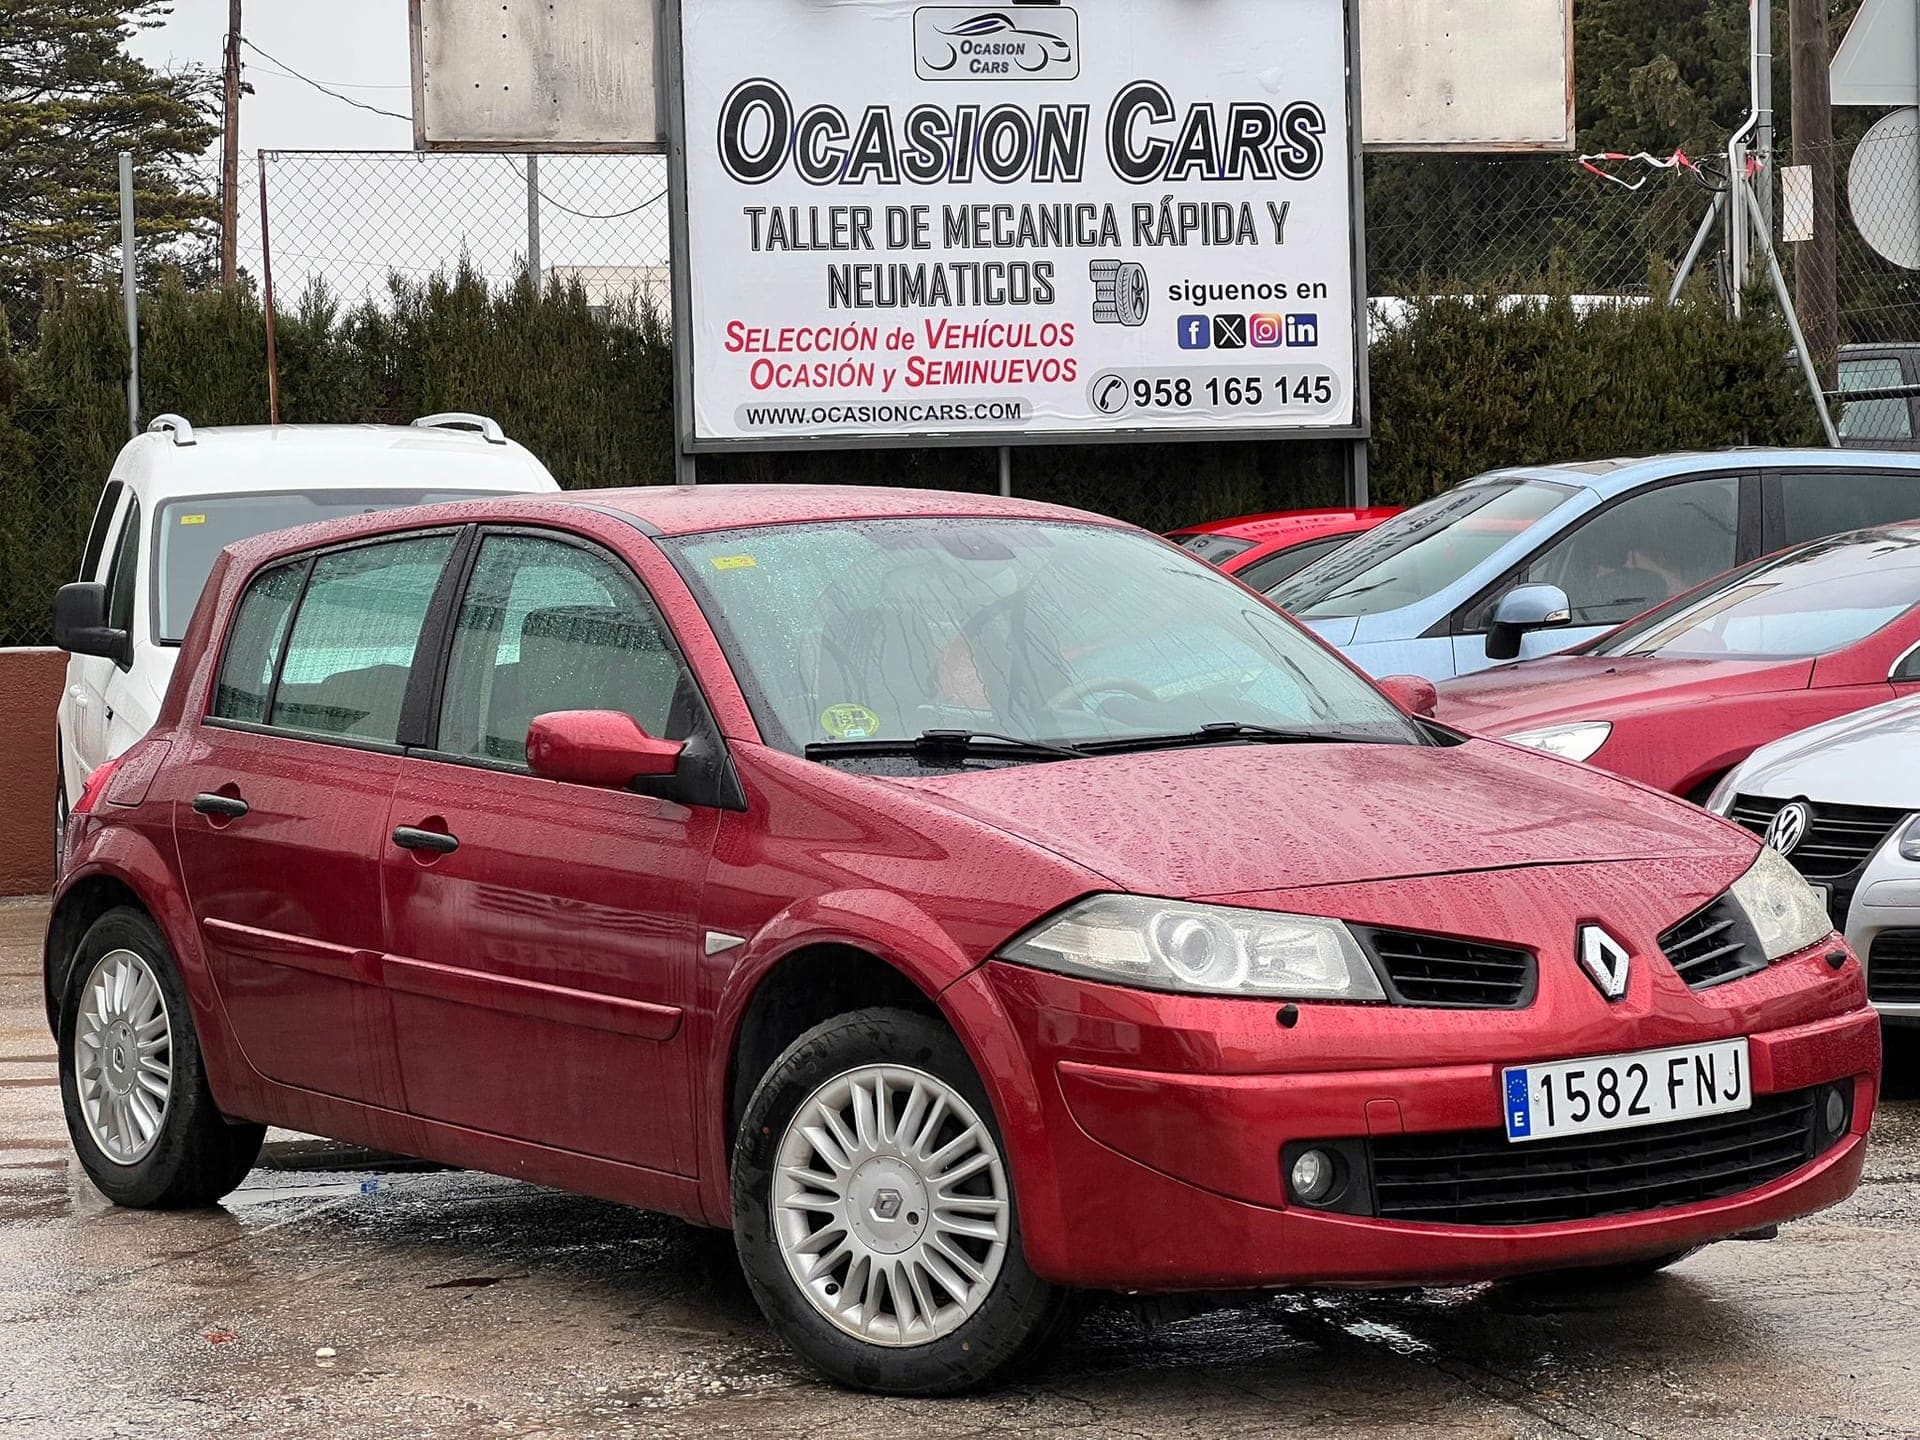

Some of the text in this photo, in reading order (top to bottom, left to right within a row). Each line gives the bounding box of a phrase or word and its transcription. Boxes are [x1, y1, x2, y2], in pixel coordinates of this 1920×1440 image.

[743, 194, 1290, 251] TALLER DE MECANICA RÁPIDA Y
[827, 261, 1055, 309] NEUMATICOS
[1168, 279, 1328, 306] siguenos en
[724, 318, 1075, 353] SELECCIÓN de VEHÍCULOS
[750, 355, 1077, 392] OCASIÓN y SEMINUEVOS
[1133, 375, 1332, 407] 958 165 145
[746, 403, 1021, 425] WWW.OCASIONCARS.COM
[1541, 1049, 1741, 1127] 1582 FNJ
[1514, 1111, 1525, 1127] E
